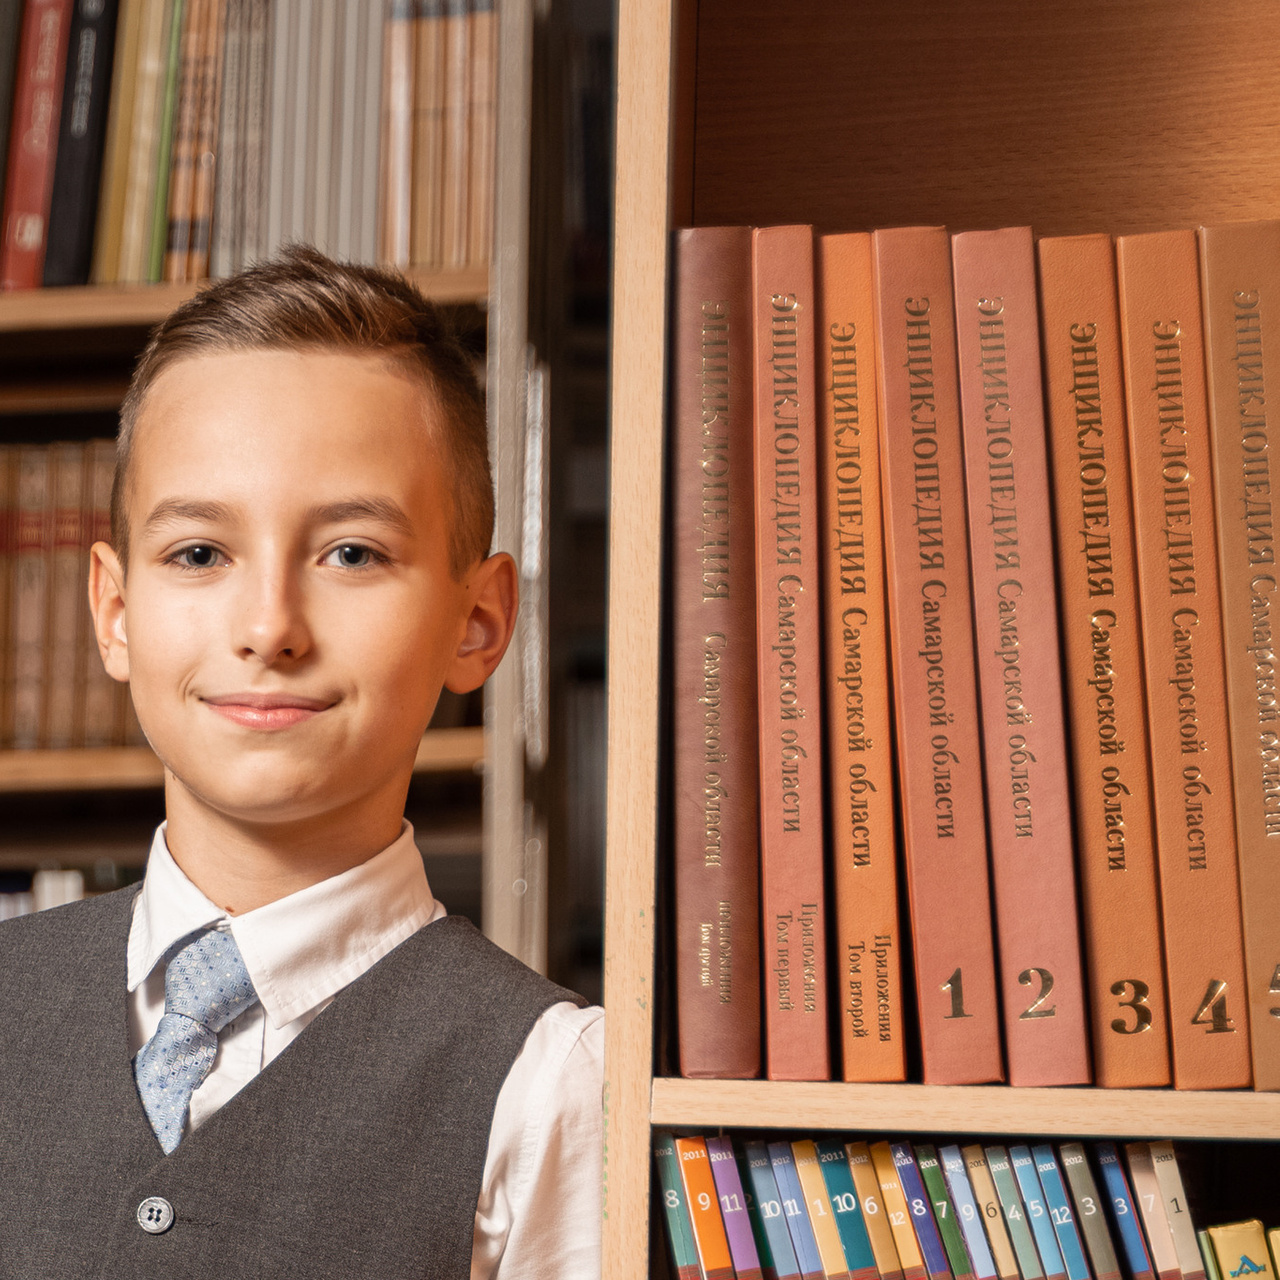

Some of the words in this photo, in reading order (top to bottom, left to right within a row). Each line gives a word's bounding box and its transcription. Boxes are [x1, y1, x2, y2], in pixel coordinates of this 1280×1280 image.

[768, 293, 803, 566] ЭНЦИКЛОПЕДИЯ
[903, 296, 946, 572] ЭНЦИКЛОПЕДИЯ
[976, 296, 1021, 572] ЭНЦИКЛОПЕДИЯ
[1231, 289, 1276, 568] ЭНЦИКЛОПЕДИЯ
[828, 321, 868, 596] ЭНЦИКЛОПЕДИЯ
[1067, 321, 1116, 599] ЭНЦИКЛОПЕДИЯ
[1150, 319, 1197, 598] ЭНЦИКЛОПЕДИЯ
[771, 574, 806, 721] Самарской
[918, 578, 955, 727] Самарской
[993, 577, 1034, 727] Самарской
[1246, 573, 1280, 723] Самарской
[836, 607, 874, 752] Самарской
[1087, 608, 1127, 757] Самарской
[1169, 606, 1209, 756] Самарской
[780, 729, 809, 834] области
[930, 734, 961, 839] области
[1007, 734, 1037, 840] области
[848, 763, 878, 869] области
[1101, 765, 1134, 873] области
[1181, 765, 1214, 872] области
[776, 910, 793, 944] Том
[797, 903, 818, 1013] Приложения
[848, 941, 866, 976] Том
[774, 948, 795, 1012] первый
[871, 934, 892, 1043] Приложения
[940, 967, 973, 1019] 1
[1017, 967, 1057, 1020] 2
[847, 980, 870, 1039] второй
[1110, 978, 1153, 1035] 3
[1190, 978, 1237, 1034] 4
[682, 1149, 707, 1161] 2011
[710, 1151, 734, 1162] 2011
[750, 1158, 768, 1168] 2012
[771, 1156, 790, 1166] 2012
[820, 1151, 846, 1163] 2011
[849, 1154, 868, 1165] 2012
[895, 1156, 914, 1167] 2013
[919, 1158, 938, 1169] 2013
[969, 1158, 988, 1169] 2013
[1014, 1156, 1032, 1167] 2013
[1064, 1155, 1084, 1166] 2012
[1155, 1152, 1174, 1163] 2013
[991, 1161, 1009, 1172] 2013
[1038, 1161, 1057, 1172] 2013
[664, 1189, 680, 1208] 8
[697, 1192, 711, 1211] 9
[721, 1193, 743, 1213] 11
[783, 1198, 802, 1217] 11
[813, 1199, 827, 1216] 1
[832, 1192, 857, 1213] 10
[864, 1196, 878, 1215] 6
[911, 1198, 927, 1216] 8
[1081, 1197, 1097, 1216] 3
[1114, 1198, 1128, 1215] 3
[1143, 1194, 1155, 1213] 7
[1170, 1197, 1184, 1214] 1
[760, 1200, 781, 1219] 10
[935, 1201, 948, 1219] 7
[961, 1204, 975, 1221] 9
[985, 1201, 998, 1219] 6
[1008, 1204, 1022, 1221] 4
[1029, 1200, 1044, 1218] 5
[1051, 1206, 1072, 1225] 12
[890, 1211, 906, 1227] 12
